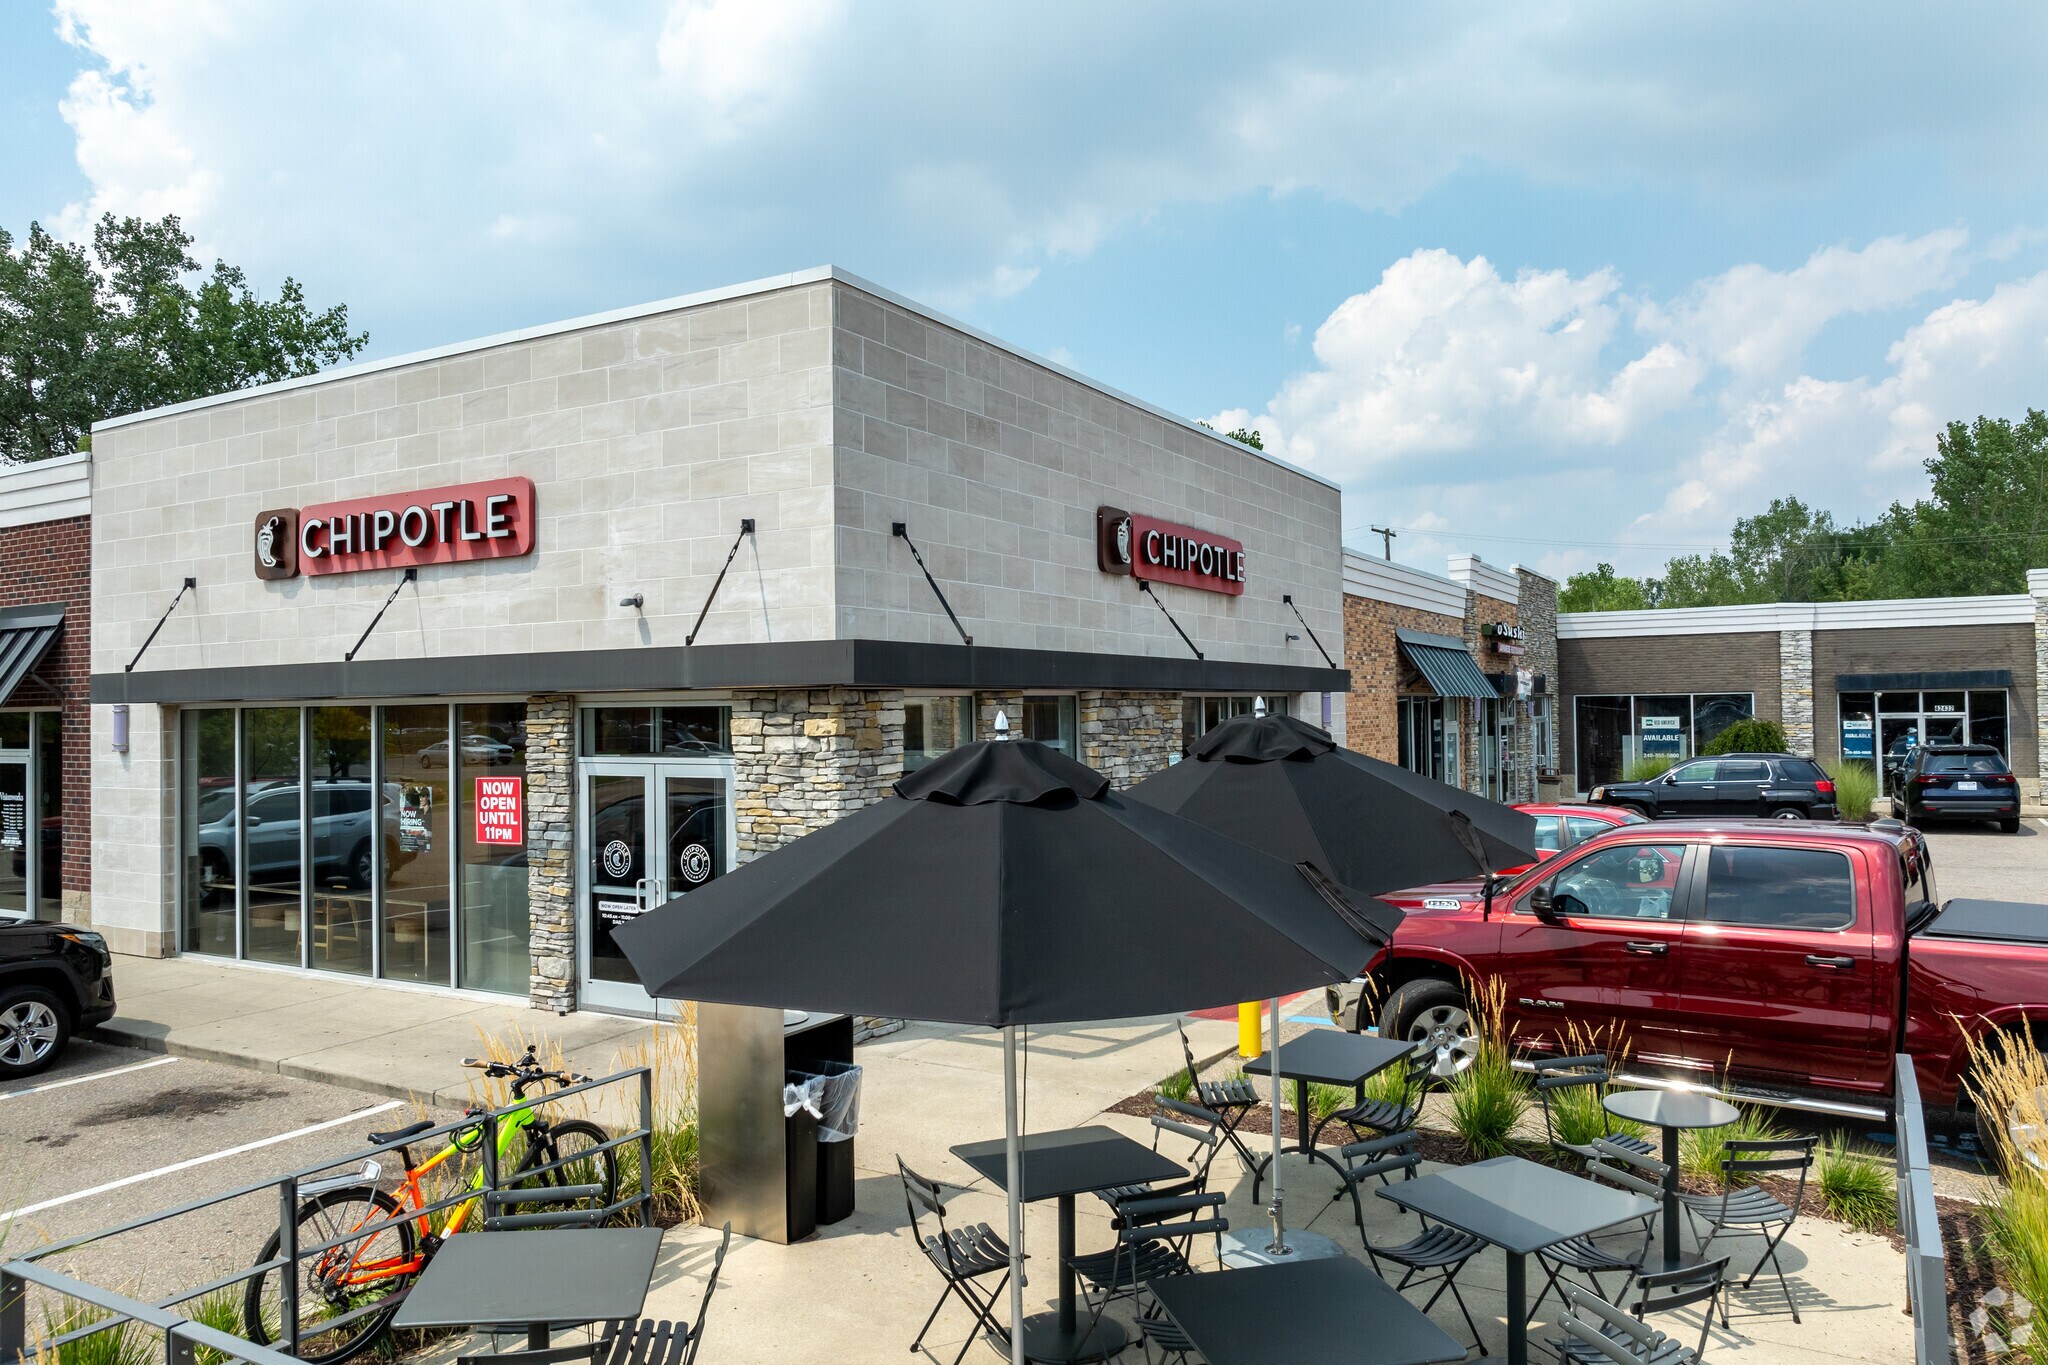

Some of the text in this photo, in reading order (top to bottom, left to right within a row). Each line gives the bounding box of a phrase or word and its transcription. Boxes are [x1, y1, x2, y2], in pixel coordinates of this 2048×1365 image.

[302, 494, 514, 558] CHIPOTLE
[1145, 529, 1247, 583] CHIPOTLE
[483, 782, 513, 795] NOW
[481, 797, 515, 810] OPEN
[400, 810, 417, 818] NOW
[480, 812, 517, 825] UNTIL
[485, 827, 512, 839] 11PM
[606, 842, 629, 857] CHIPOTLE
[683, 846, 708, 861] CHIPOTLE
[1519, 997, 1565, 1008] RAM
